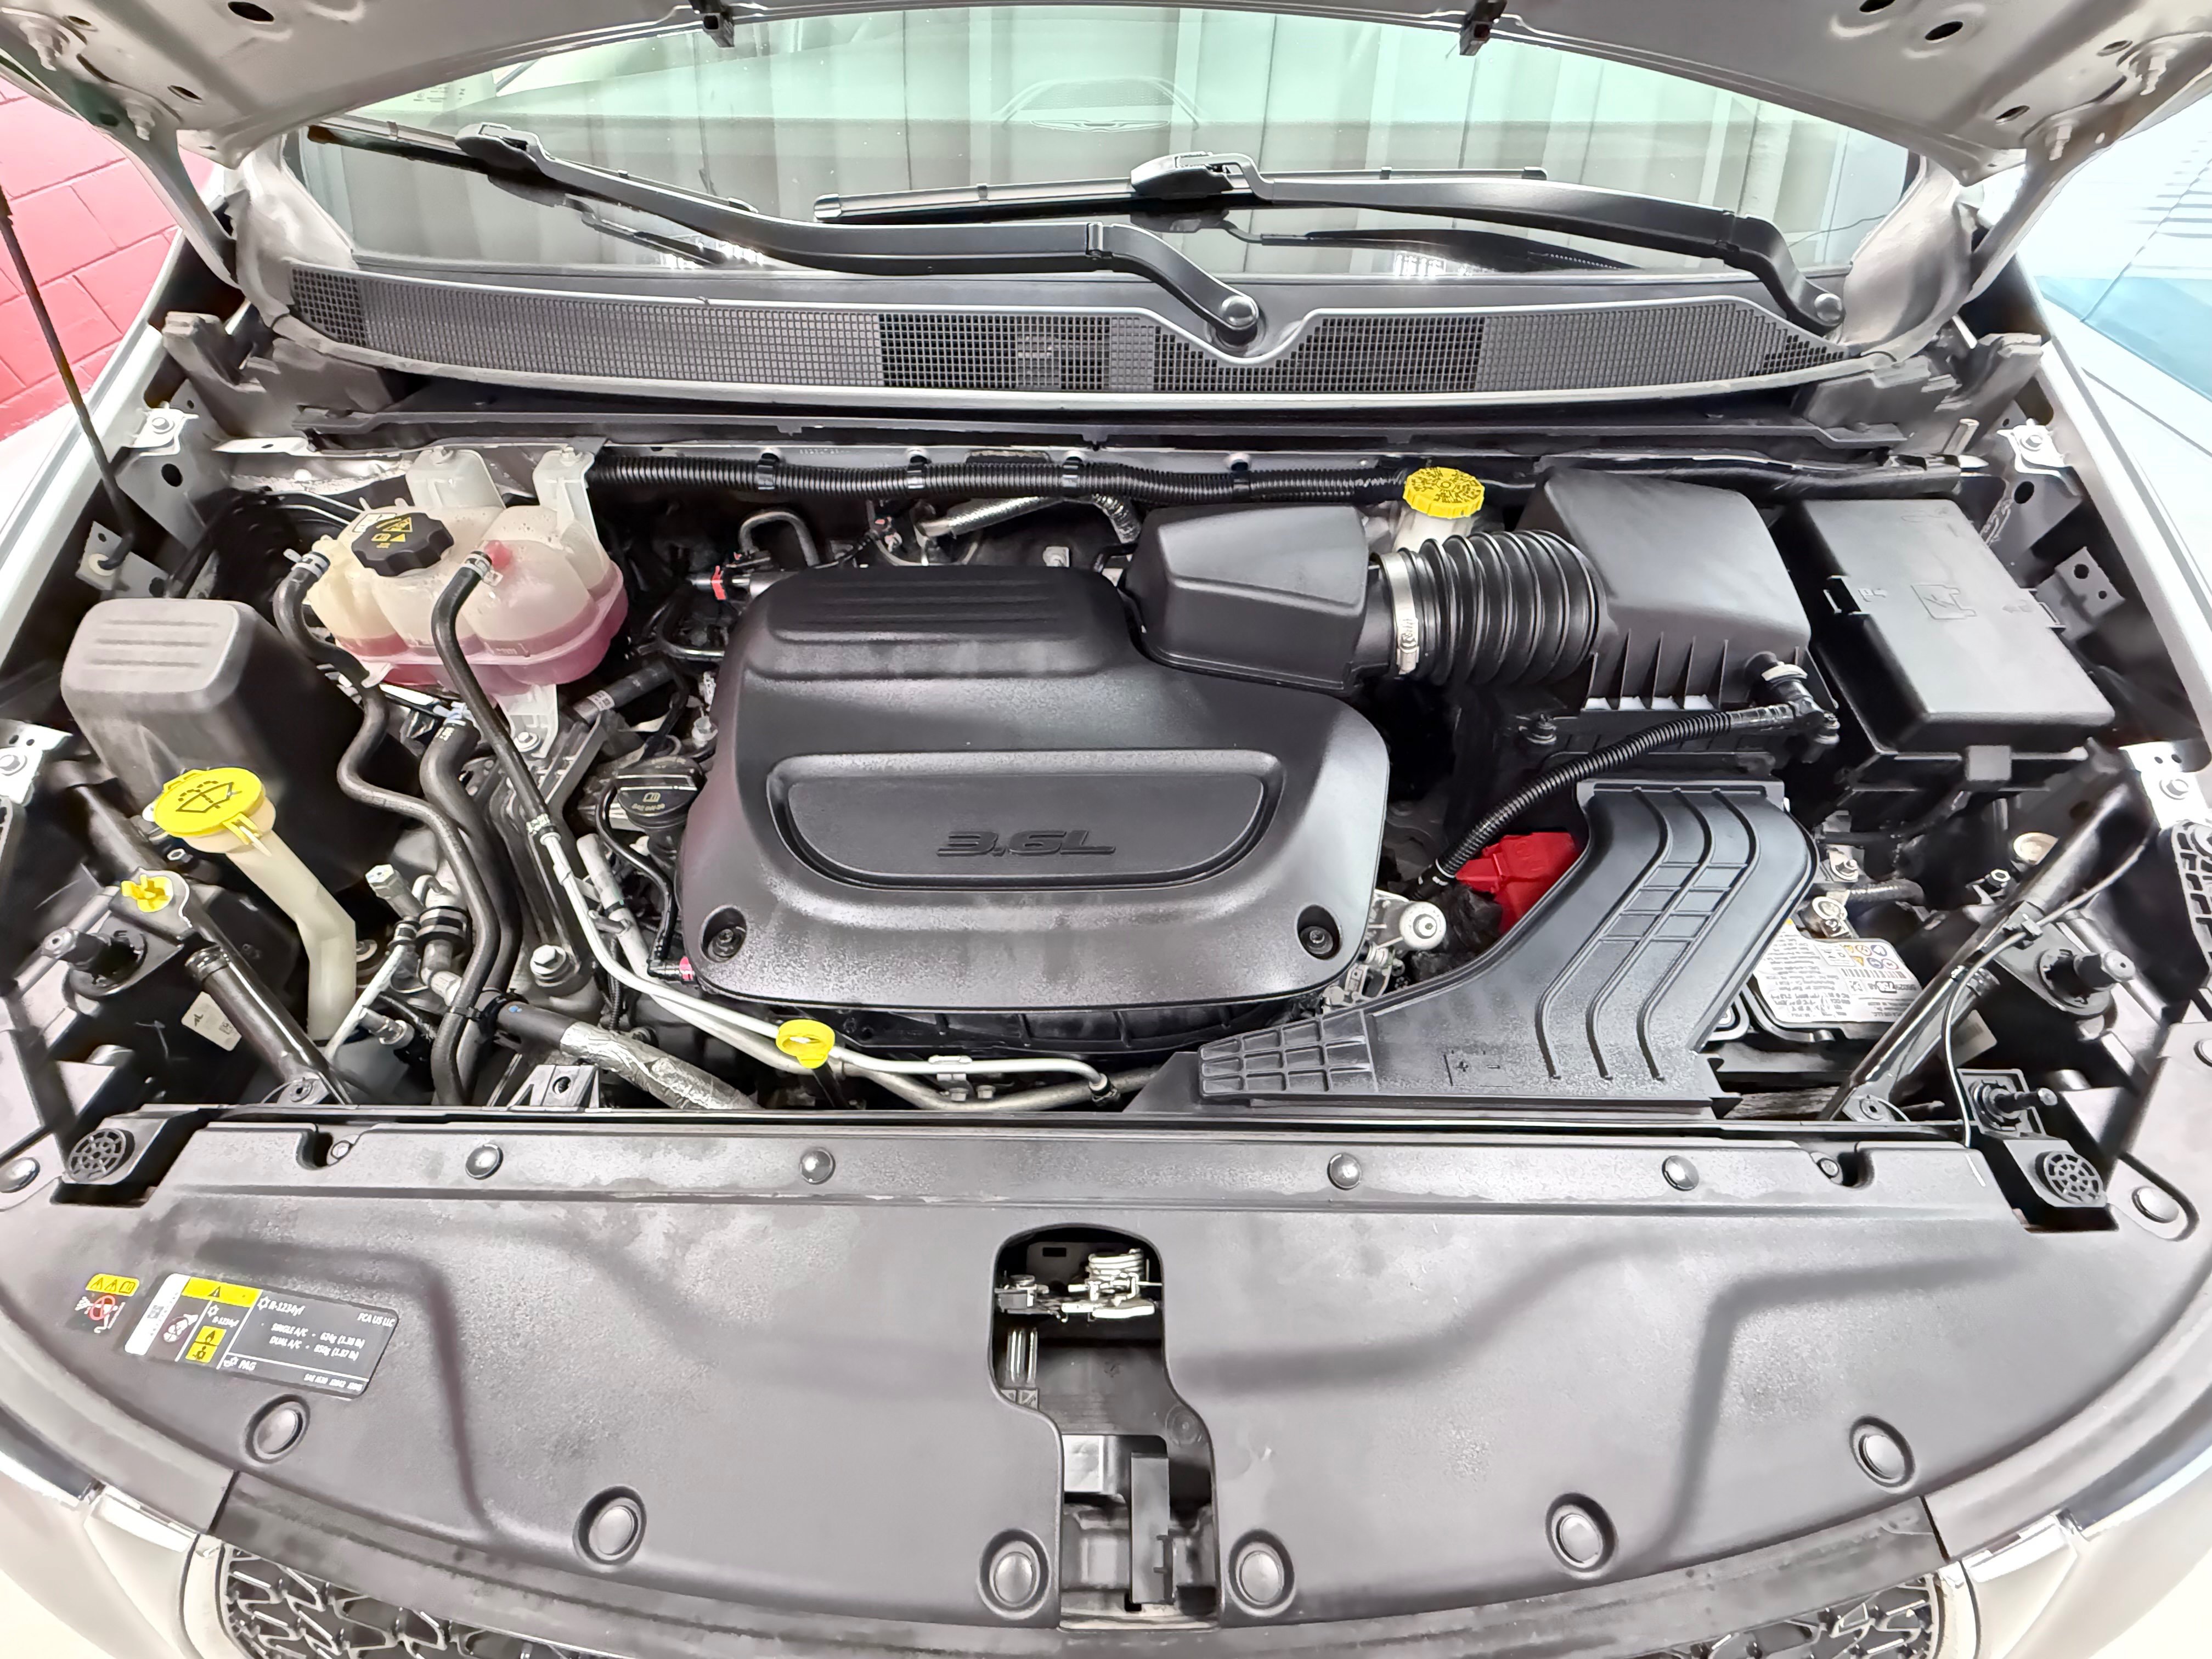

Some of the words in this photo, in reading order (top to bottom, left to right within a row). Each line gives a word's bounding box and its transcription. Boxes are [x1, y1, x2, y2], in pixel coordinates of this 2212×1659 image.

[936, 830, 1116, 856] 3.6L
[358, 1313, 371, 1323] FCA
[373, 1316, 383, 1324] US
[382, 1317, 395, 1327] LLC
[271, 1323, 296, 1334] SINGLE
[294, 1328, 309, 1337] A/C
[269, 1336, 288, 1346] DUAL
[287, 1340, 302, 1350] A/C
[238, 1361, 257, 1372] PAG
